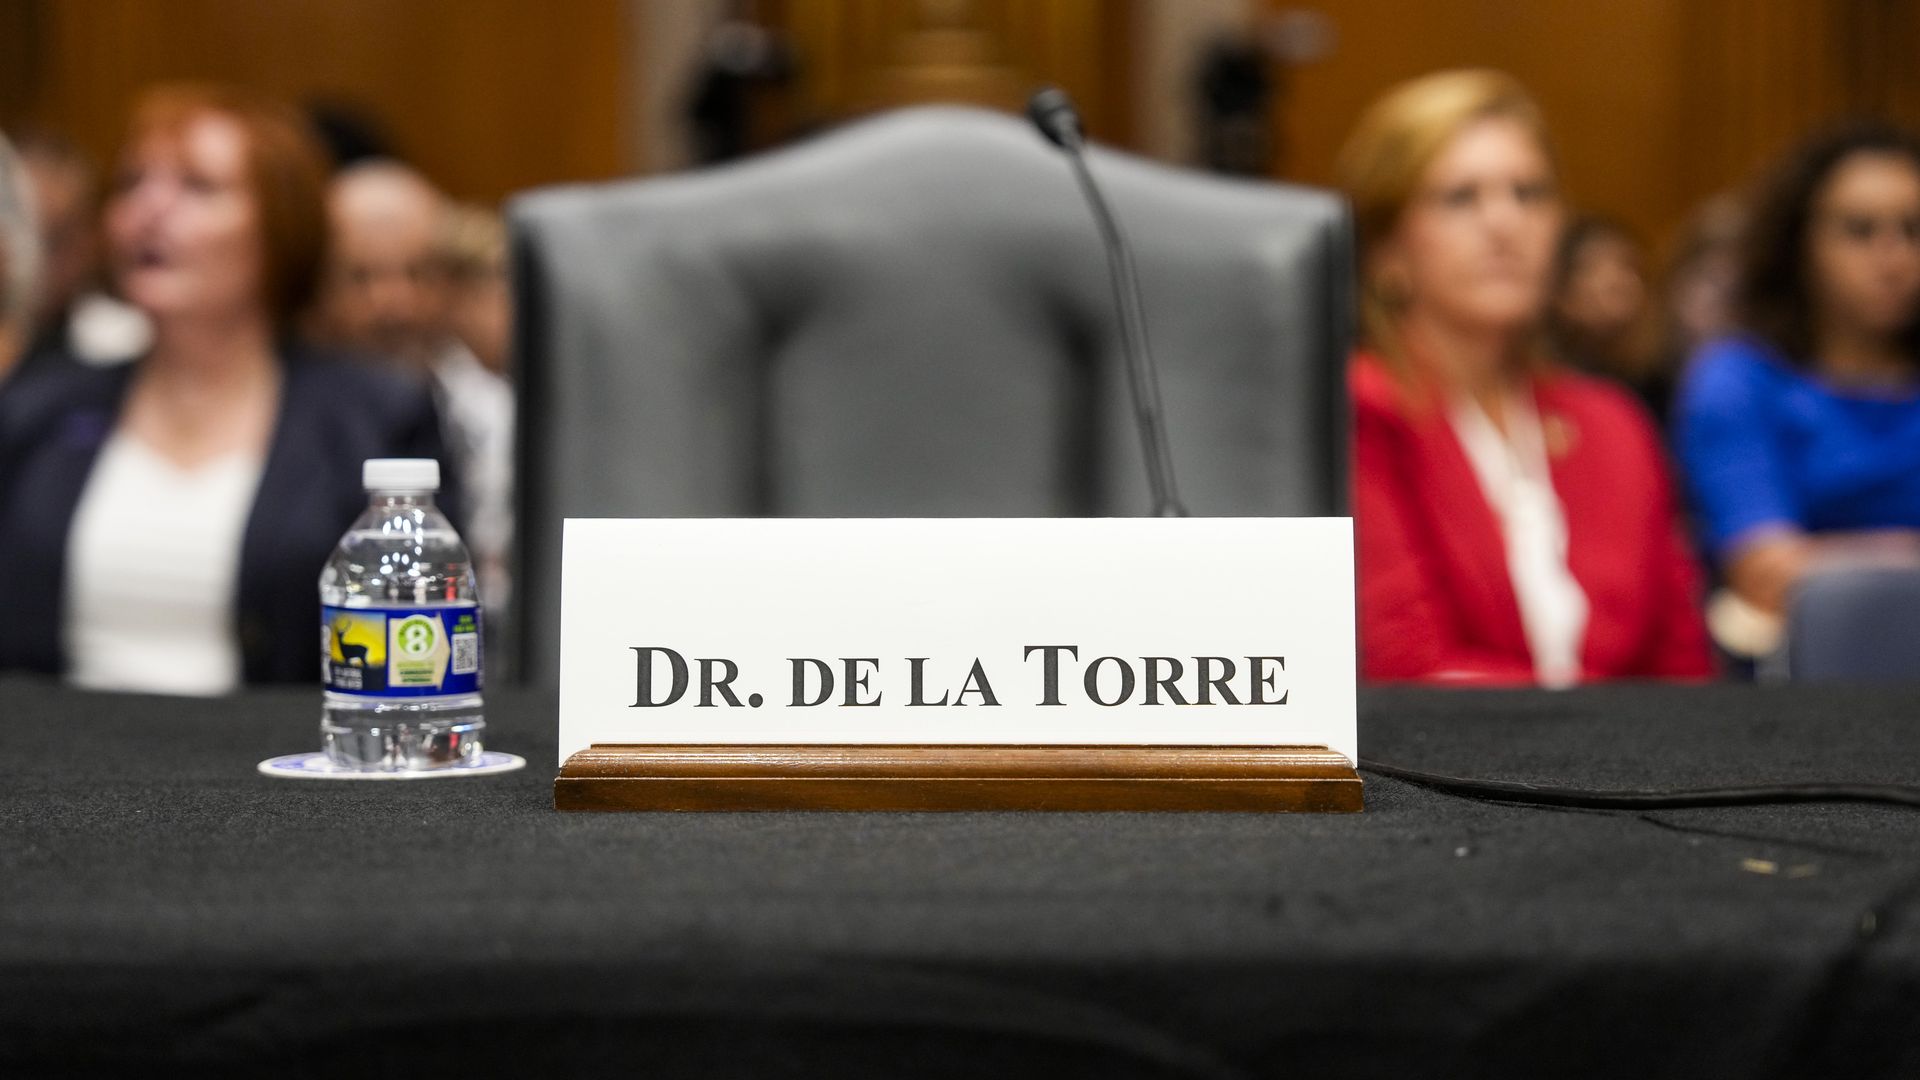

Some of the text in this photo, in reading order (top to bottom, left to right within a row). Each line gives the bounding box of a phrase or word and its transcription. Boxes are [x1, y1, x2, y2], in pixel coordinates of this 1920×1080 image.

[628, 645, 1289, 708] DR. DE LA TORRE
